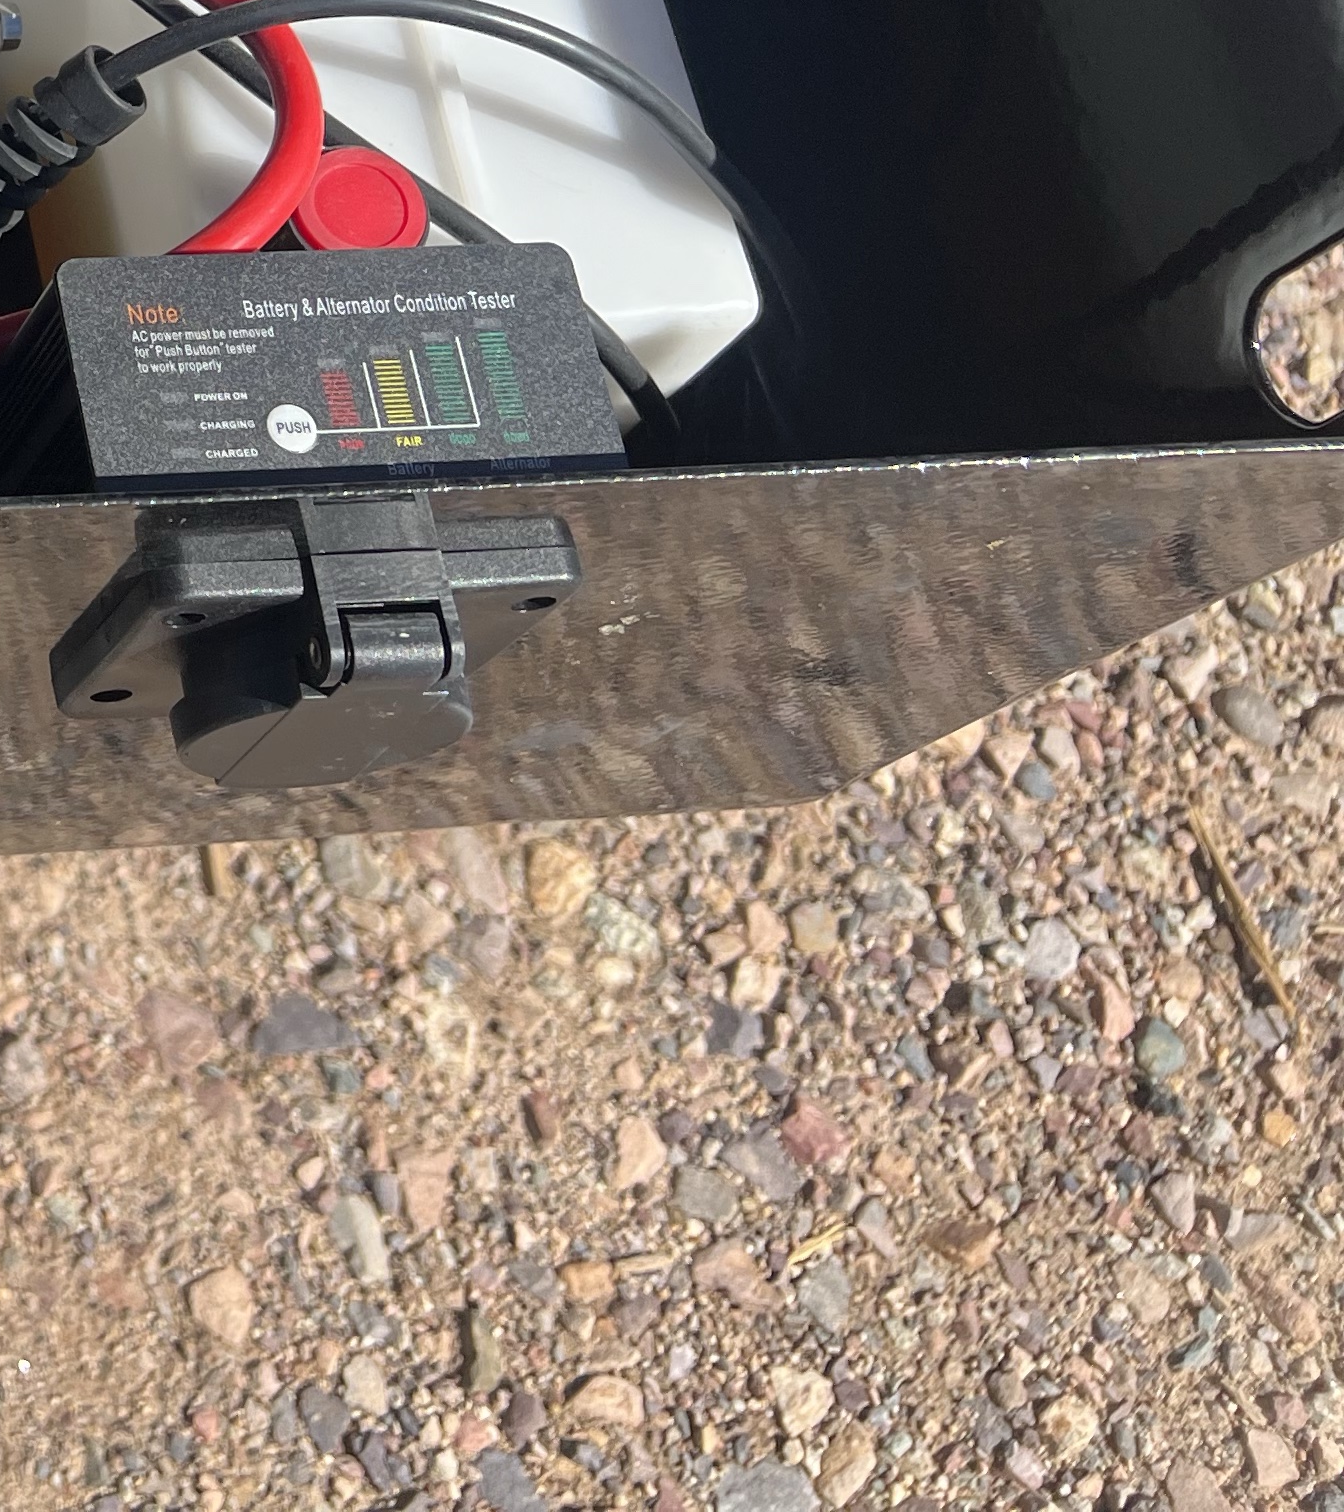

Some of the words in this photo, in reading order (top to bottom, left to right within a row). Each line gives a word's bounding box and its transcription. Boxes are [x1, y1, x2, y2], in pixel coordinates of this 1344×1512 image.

[242, 298, 298, 322] Battery
[301, 297, 314, 317] &
[316, 293, 391, 317] Alternator
[394, 290, 468, 315] Condition
[467, 289, 516, 311] Tester
[132, 330, 149, 343] AC
[150, 330, 183, 344] power
[184, 328, 212, 342] must
[212, 327, 227, 340] be
[228, 325, 275, 339] removed
[134, 345, 150, 359] for
[225, 342, 258, 355] tester
[137, 361, 149, 374] to
[150, 360, 177, 373] work
[178, 358, 223, 374] properly
[193, 392, 231, 402] POWER
[233, 391, 248, 401] ON
[199, 418, 256, 431] CHARGING
[275, 420, 312, 435] PUSH
[395, 434, 424, 448] FAIR
[205, 447, 259, 460] CHARGED
[387, 461, 436, 478] Battery
[491, 456, 552, 472] Alternator
